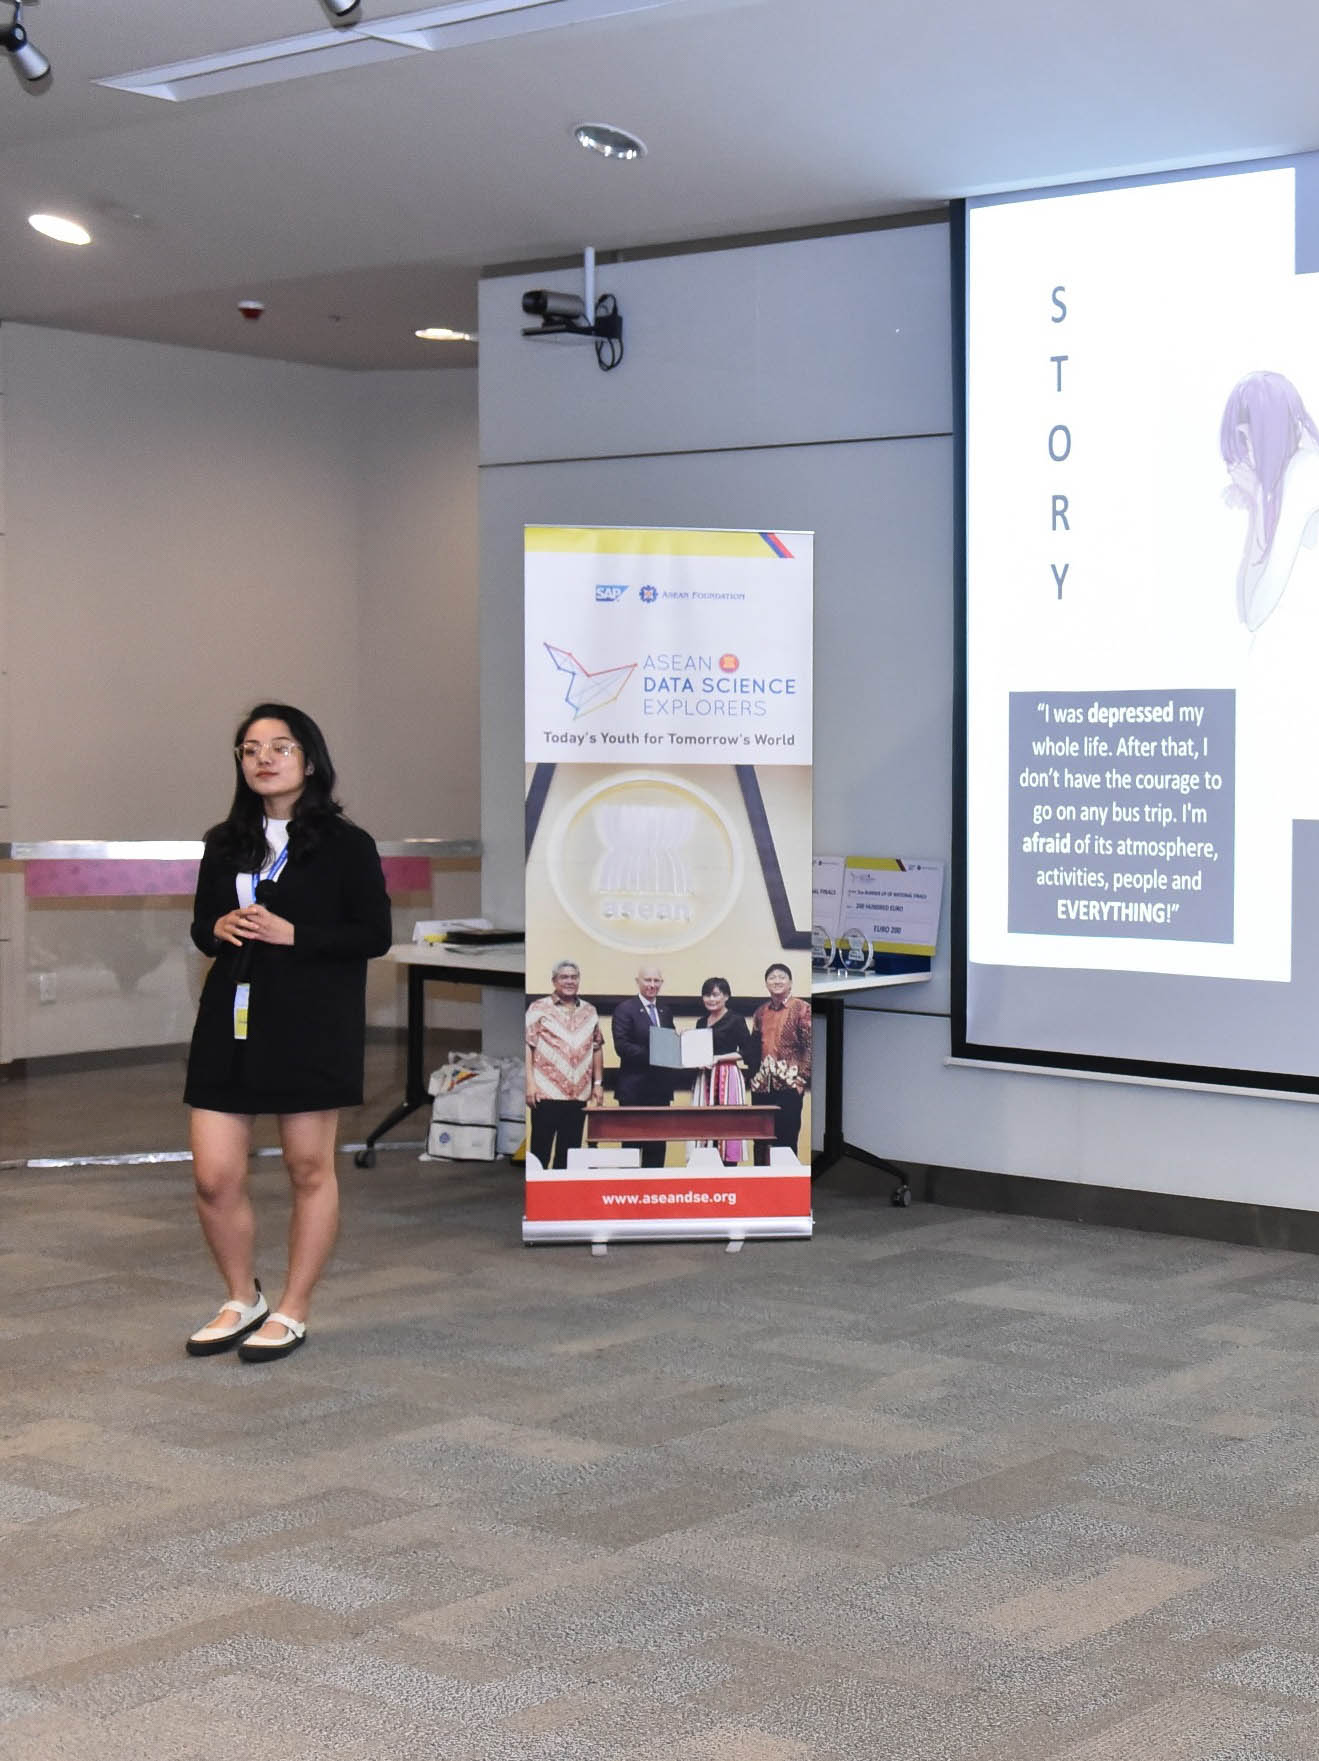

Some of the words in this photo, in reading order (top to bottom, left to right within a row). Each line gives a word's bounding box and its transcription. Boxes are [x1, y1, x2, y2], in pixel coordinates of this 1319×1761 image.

[1048, 286, 1072, 599] STORY
[596, 586, 624, 600] SAP
[643, 655, 712, 672] ASEAN
[644, 678, 694, 694] DATA
[702, 678, 796, 695] SCIENCE
[644, 699, 767, 716] EXPLORERS
[1054, 708, 1083, 723] was
[1088, 700, 1173, 727] depressed
[1180, 706, 1204, 725] my
[544, 731, 597, 746] Today's
[601, 732, 639, 744] Youth
[644, 732, 663, 745] for
[668, 733, 750, 745] Tomorrow's
[754, 733, 795, 746] World
[1033, 738, 1079, 756] whole
[1084, 737, 1112, 756] life.
[1116, 737, 1157, 757] After
[1161, 738, 1198, 759] that,
[1203, 738, 1208, 756] I
[1065, 769, 1101, 788] have
[1105, 770, 1131, 789] the
[1136, 774, 1199, 794] courage
[1205, 772, 1221, 789] to
[1033, 805, 1051, 824] go
[1057, 806, 1075, 820] on
[1081, 806, 1107, 825] any
[1113, 802, 1139, 822] bus
[1144, 804, 1177, 826] trip.
[1182, 804, 1207, 823] I'm
[1023, 833, 1070, 853] afraid
[1075, 835, 1090, 854] of
[1094, 835, 1112, 855] its
[1117, 836, 1218, 860] atmosphere,
[1037, 866, 1109, 890] activities,
[1113, 869, 1167, 892] people
[1172, 871, 1202, 890] and
[874, 925, 889, 934] EURO
[602, 1191, 736, 1206] www.aseandse.org
